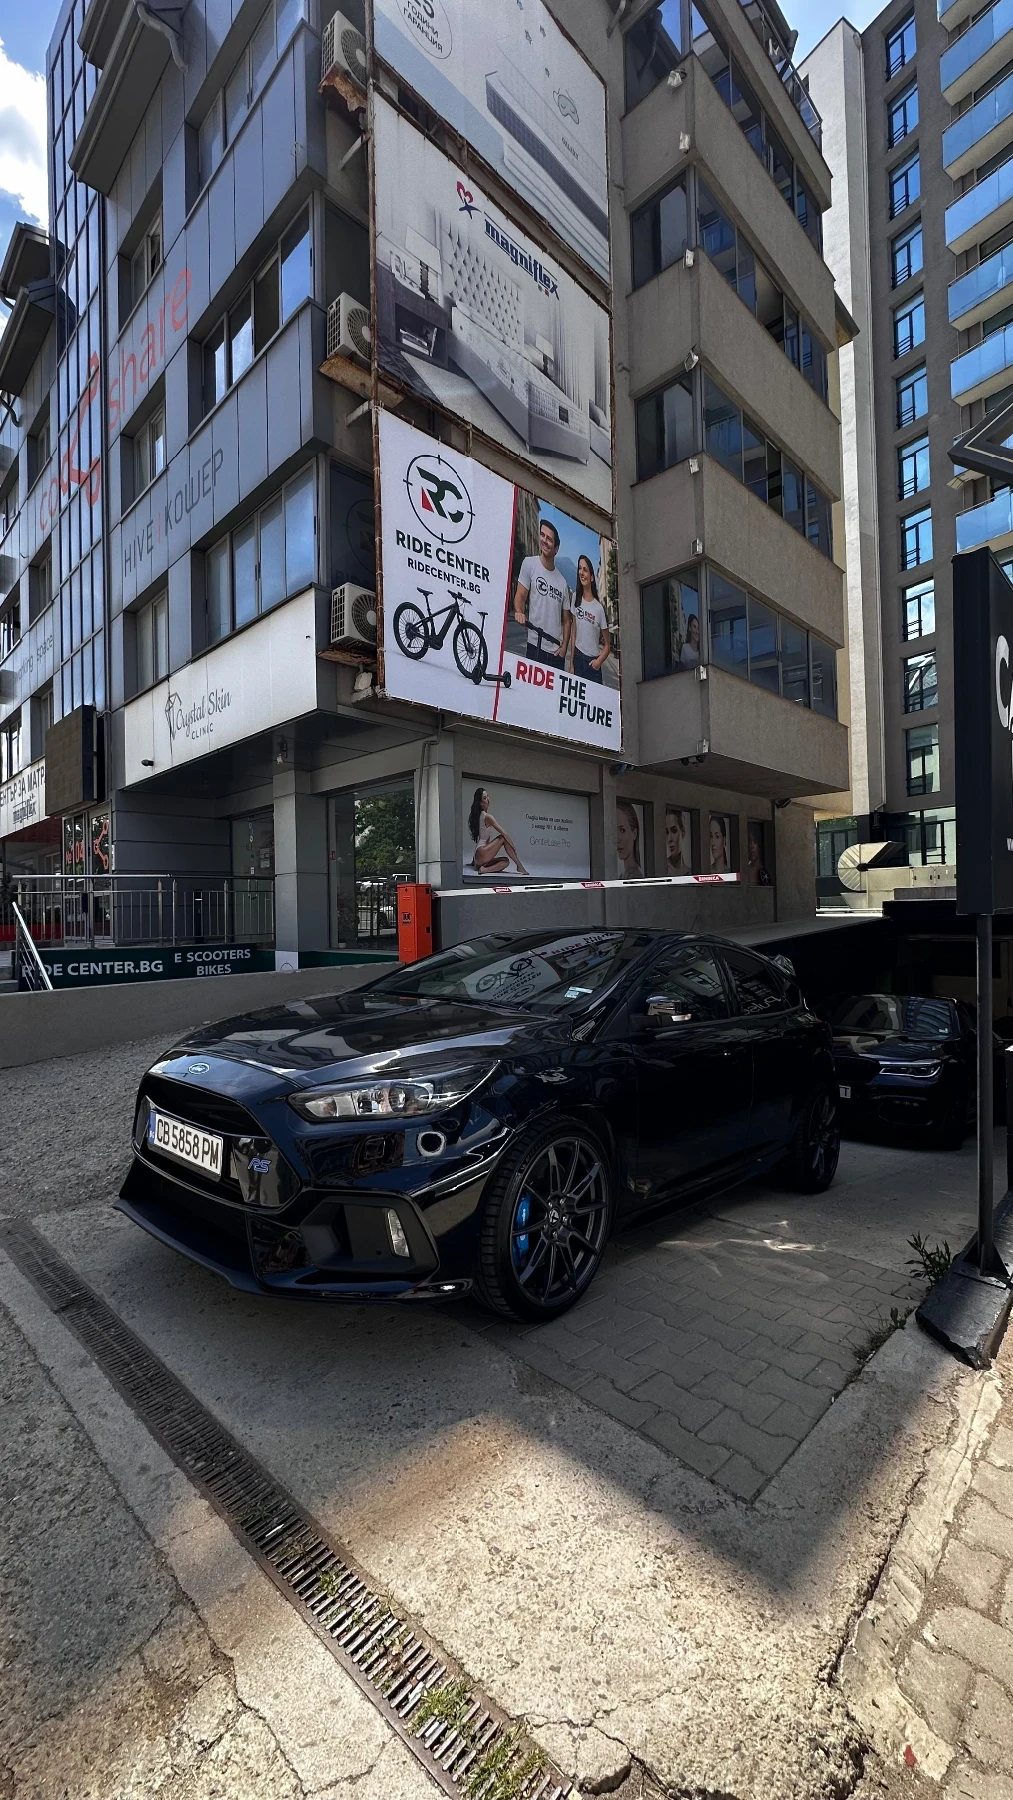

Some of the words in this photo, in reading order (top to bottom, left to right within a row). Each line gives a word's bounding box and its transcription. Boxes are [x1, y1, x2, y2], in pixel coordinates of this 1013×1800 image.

[403, 7, 443, 54] ГАРАНЦИЯ
[407, 1, 438, 39] ГОДИНИ
[484, 218, 560, 300] magniflex
[108, 267, 192, 431] share
[165, 448, 223, 537] КОШЕР
[124, 519, 154, 578] HIVE
[396, 529, 433, 559] RIDE
[435, 547, 490, 583] CENTER
[407, 557, 481, 595] RIDECENTER.BG
[515, 660, 555, 690] RIDE
[559, 674, 587, 701] THE
[176, 695, 206, 738] Crystal
[207, 688, 232, 716] Skin
[191, 722, 214, 740] CLINIC
[558, 695, 613, 728] FUTURE
[17, 777, 27, 798] ЗА
[27, 765, 46, 793] МАТР
[67, 960, 164, 976] CENTER.BG
[174, 952, 182, 963] E
[186, 948, 251, 963] SCOOTERS
[196, 963, 232, 976] BIKES
[156, 1118, 170, 1146] CB
[172, 1125, 199, 1160] 5858
[201, 1136, 219, 1169] PM
[247, 1157, 271, 1173] RS
